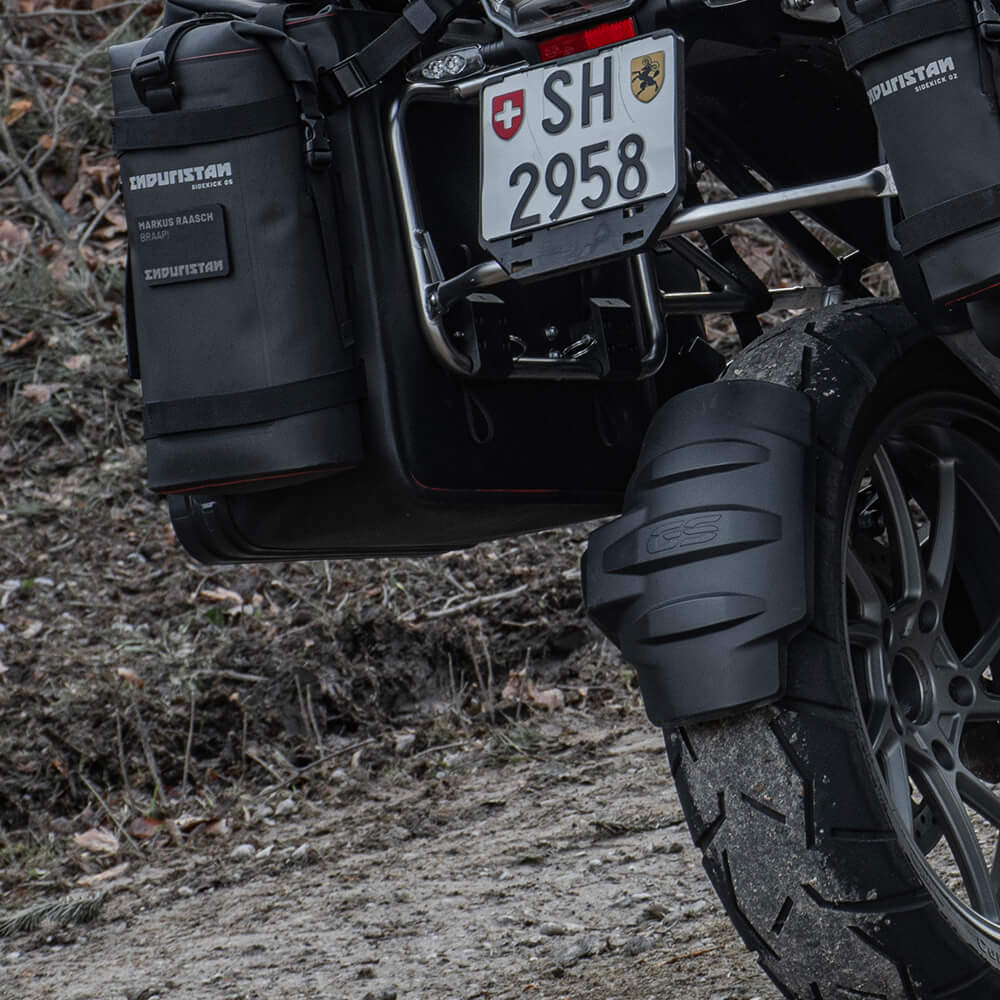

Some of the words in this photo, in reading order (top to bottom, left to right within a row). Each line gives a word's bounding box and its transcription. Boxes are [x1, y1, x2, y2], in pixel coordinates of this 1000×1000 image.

[541, 55, 613, 135] SH
[866, 56, 955, 105] NDURISTAN
[914, 77, 947, 93] SIDEKICK
[509, 133, 648, 231] 2958
[138, 217, 174, 231] MARKUS
[175, 212, 214, 226] RAASCH
